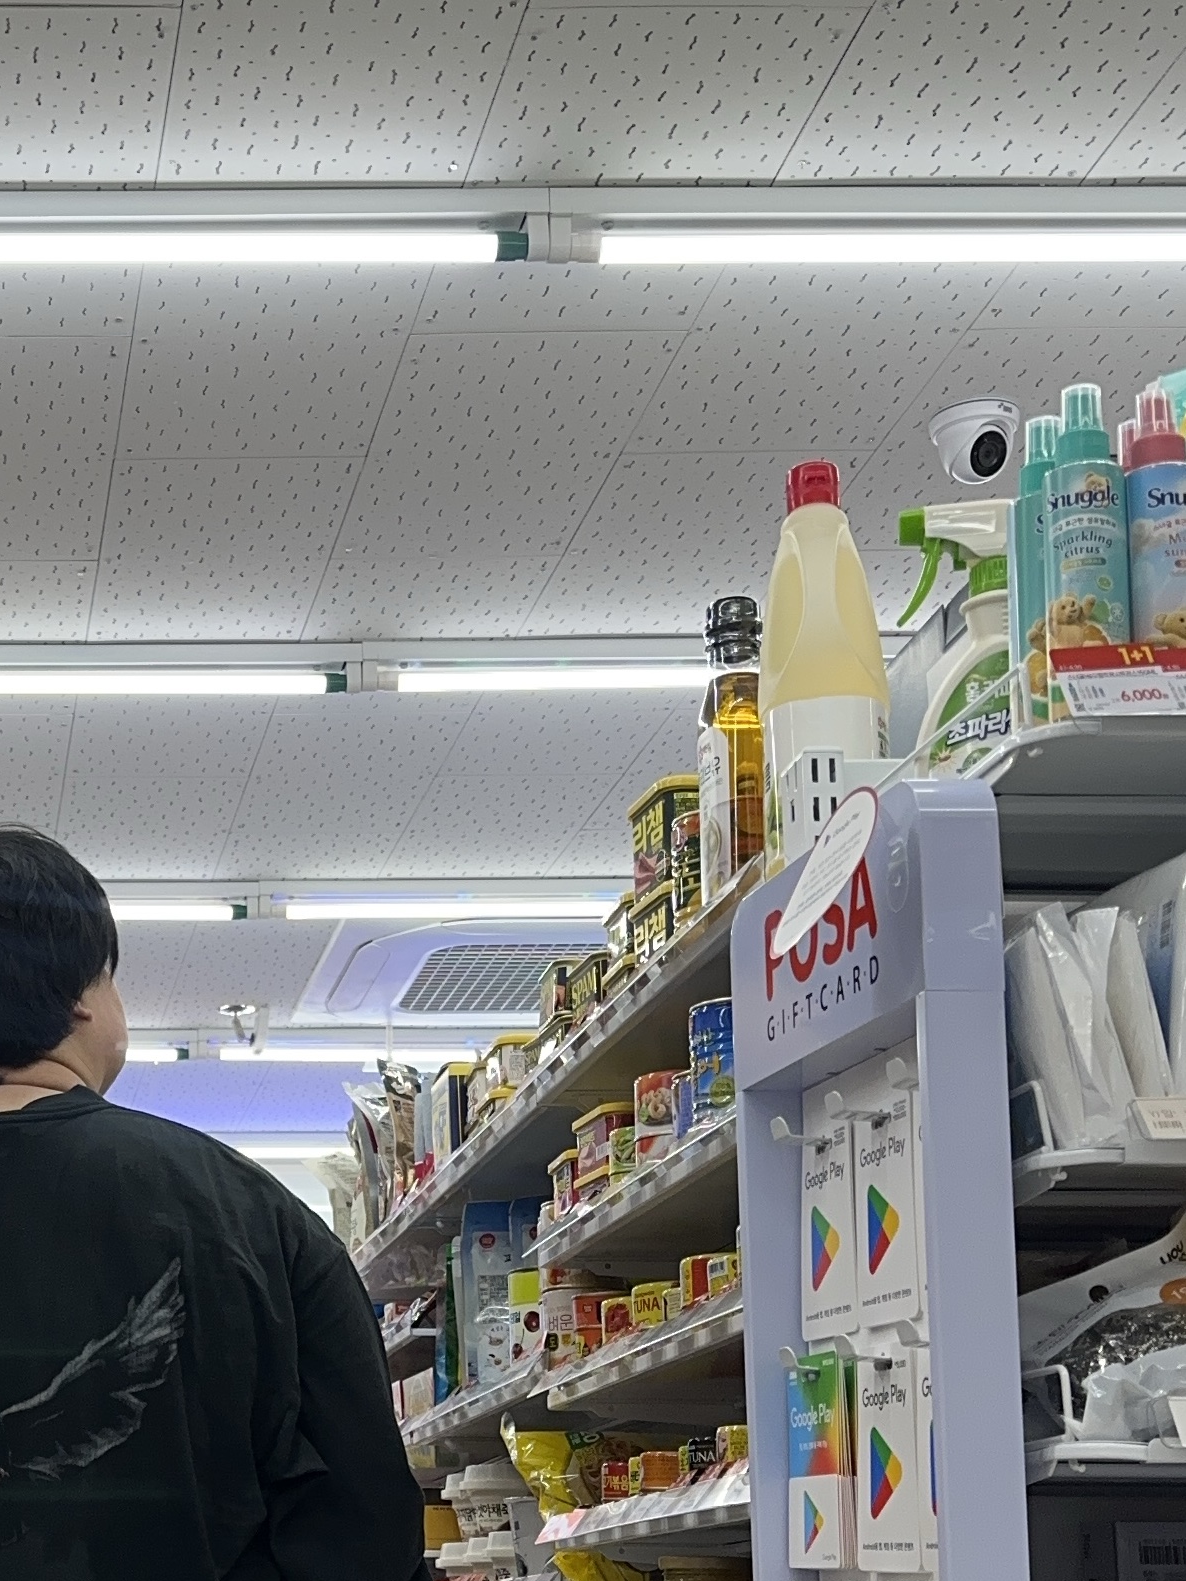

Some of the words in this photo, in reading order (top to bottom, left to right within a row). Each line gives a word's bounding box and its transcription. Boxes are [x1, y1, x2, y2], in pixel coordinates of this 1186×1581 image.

[1046, 478, 1120, 513] Snuggle
[1147, 487, 1186, 509] Snu
[1117, 645, 1155, 666] 1+1
[632, 799, 665, 853] 리챔
[633, 902, 666, 956] 리챔
[571, 969, 597, 1007] SPAM
[860, 1142, 887, 1168] Google
[888, 1136, 906, 1158] Play
[805, 1166, 829, 1191] Google
[829, 1161, 845, 1181] Play
[633, 1297, 661, 1315] TUNA
[862, 1389, 889, 1411] Google
[890, 1384, 907, 1408] Play
[790, 1406, 818, 1431] Google
[818, 1403, 834, 1426] Play
[688, 1450, 715, 1464] TUNA
